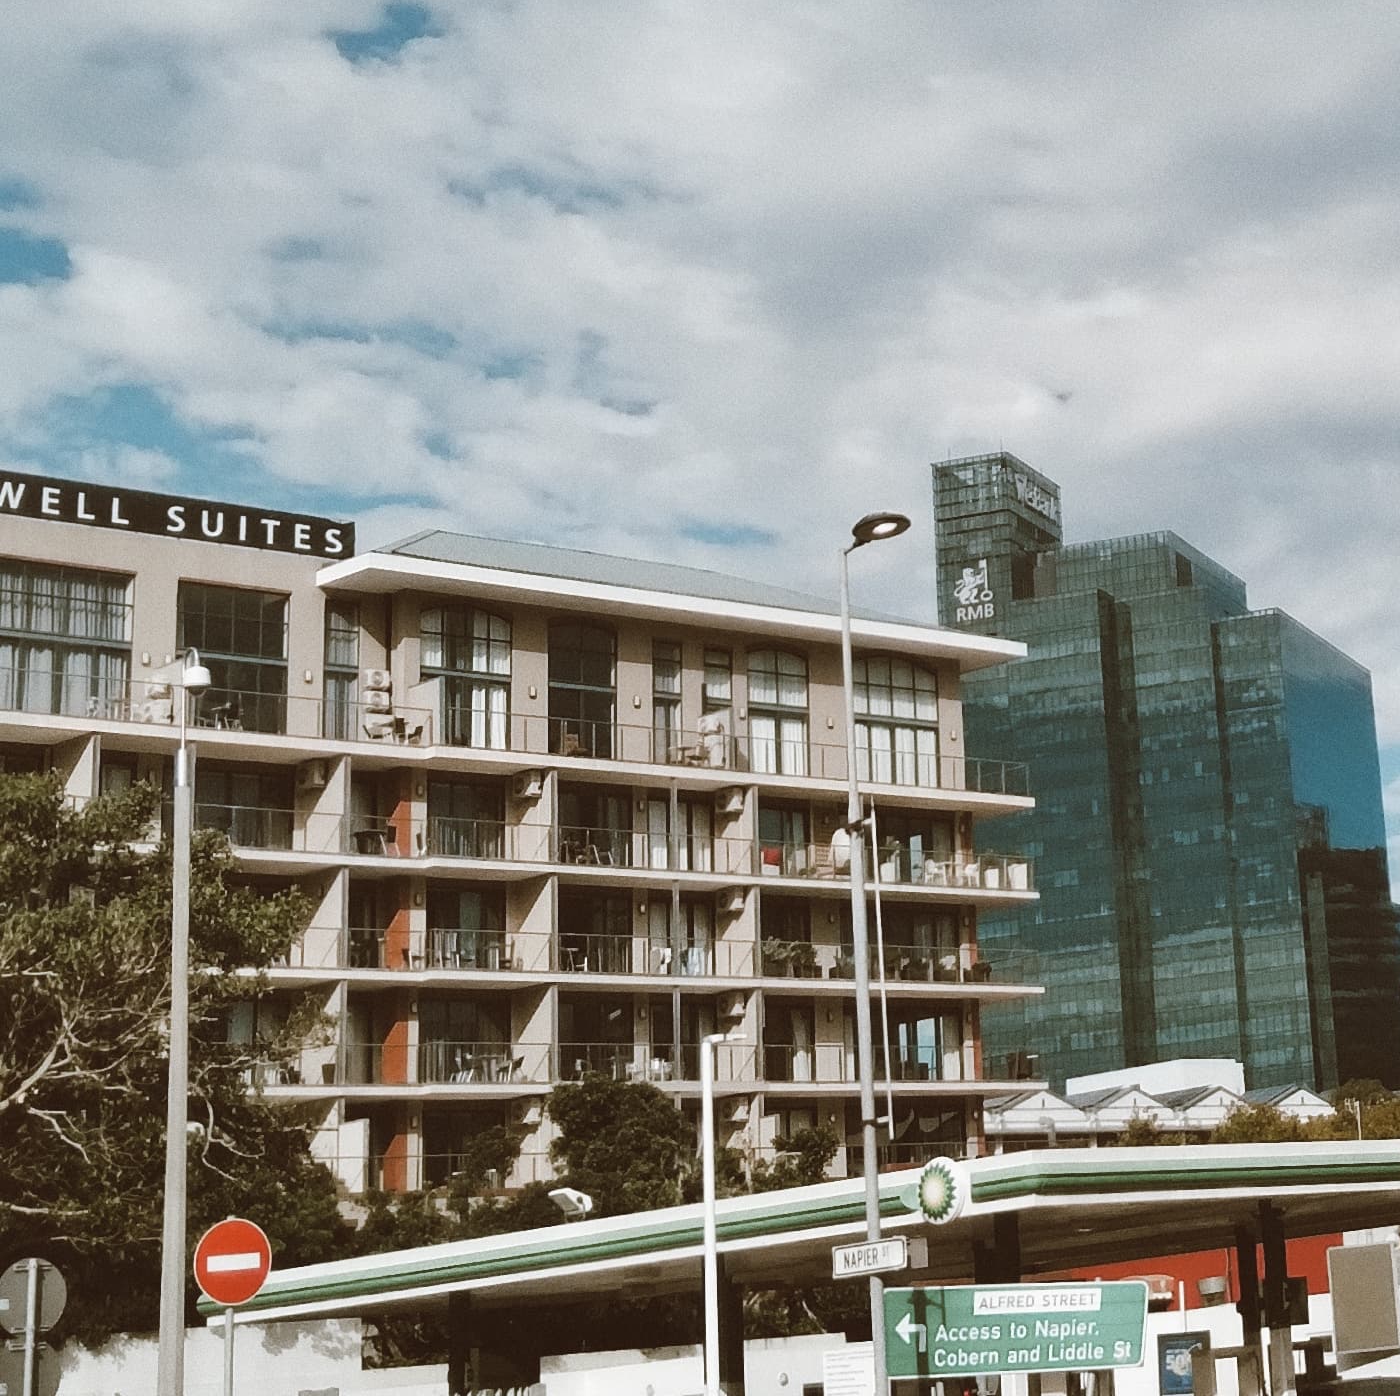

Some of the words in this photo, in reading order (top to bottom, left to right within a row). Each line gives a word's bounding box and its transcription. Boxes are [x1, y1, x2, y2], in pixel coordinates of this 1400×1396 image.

[167, 506, 343, 553] SUITES
[957, 604, 994, 622] RMB
[843, 1247, 879, 1269] NAPIER
[978, 1293, 1035, 1310] ALFRED
[1042, 1292, 1097, 1308] STREET
[935, 1322, 1001, 1342] Access
[1010, 1321, 1027, 1340] to
[934, 1346, 999, 1367] Cobern
[1007, 1345, 1040, 1364] and
[1049, 1342, 1104, 1362] Liddle
[1113, 1341, 1131, 1359] St
